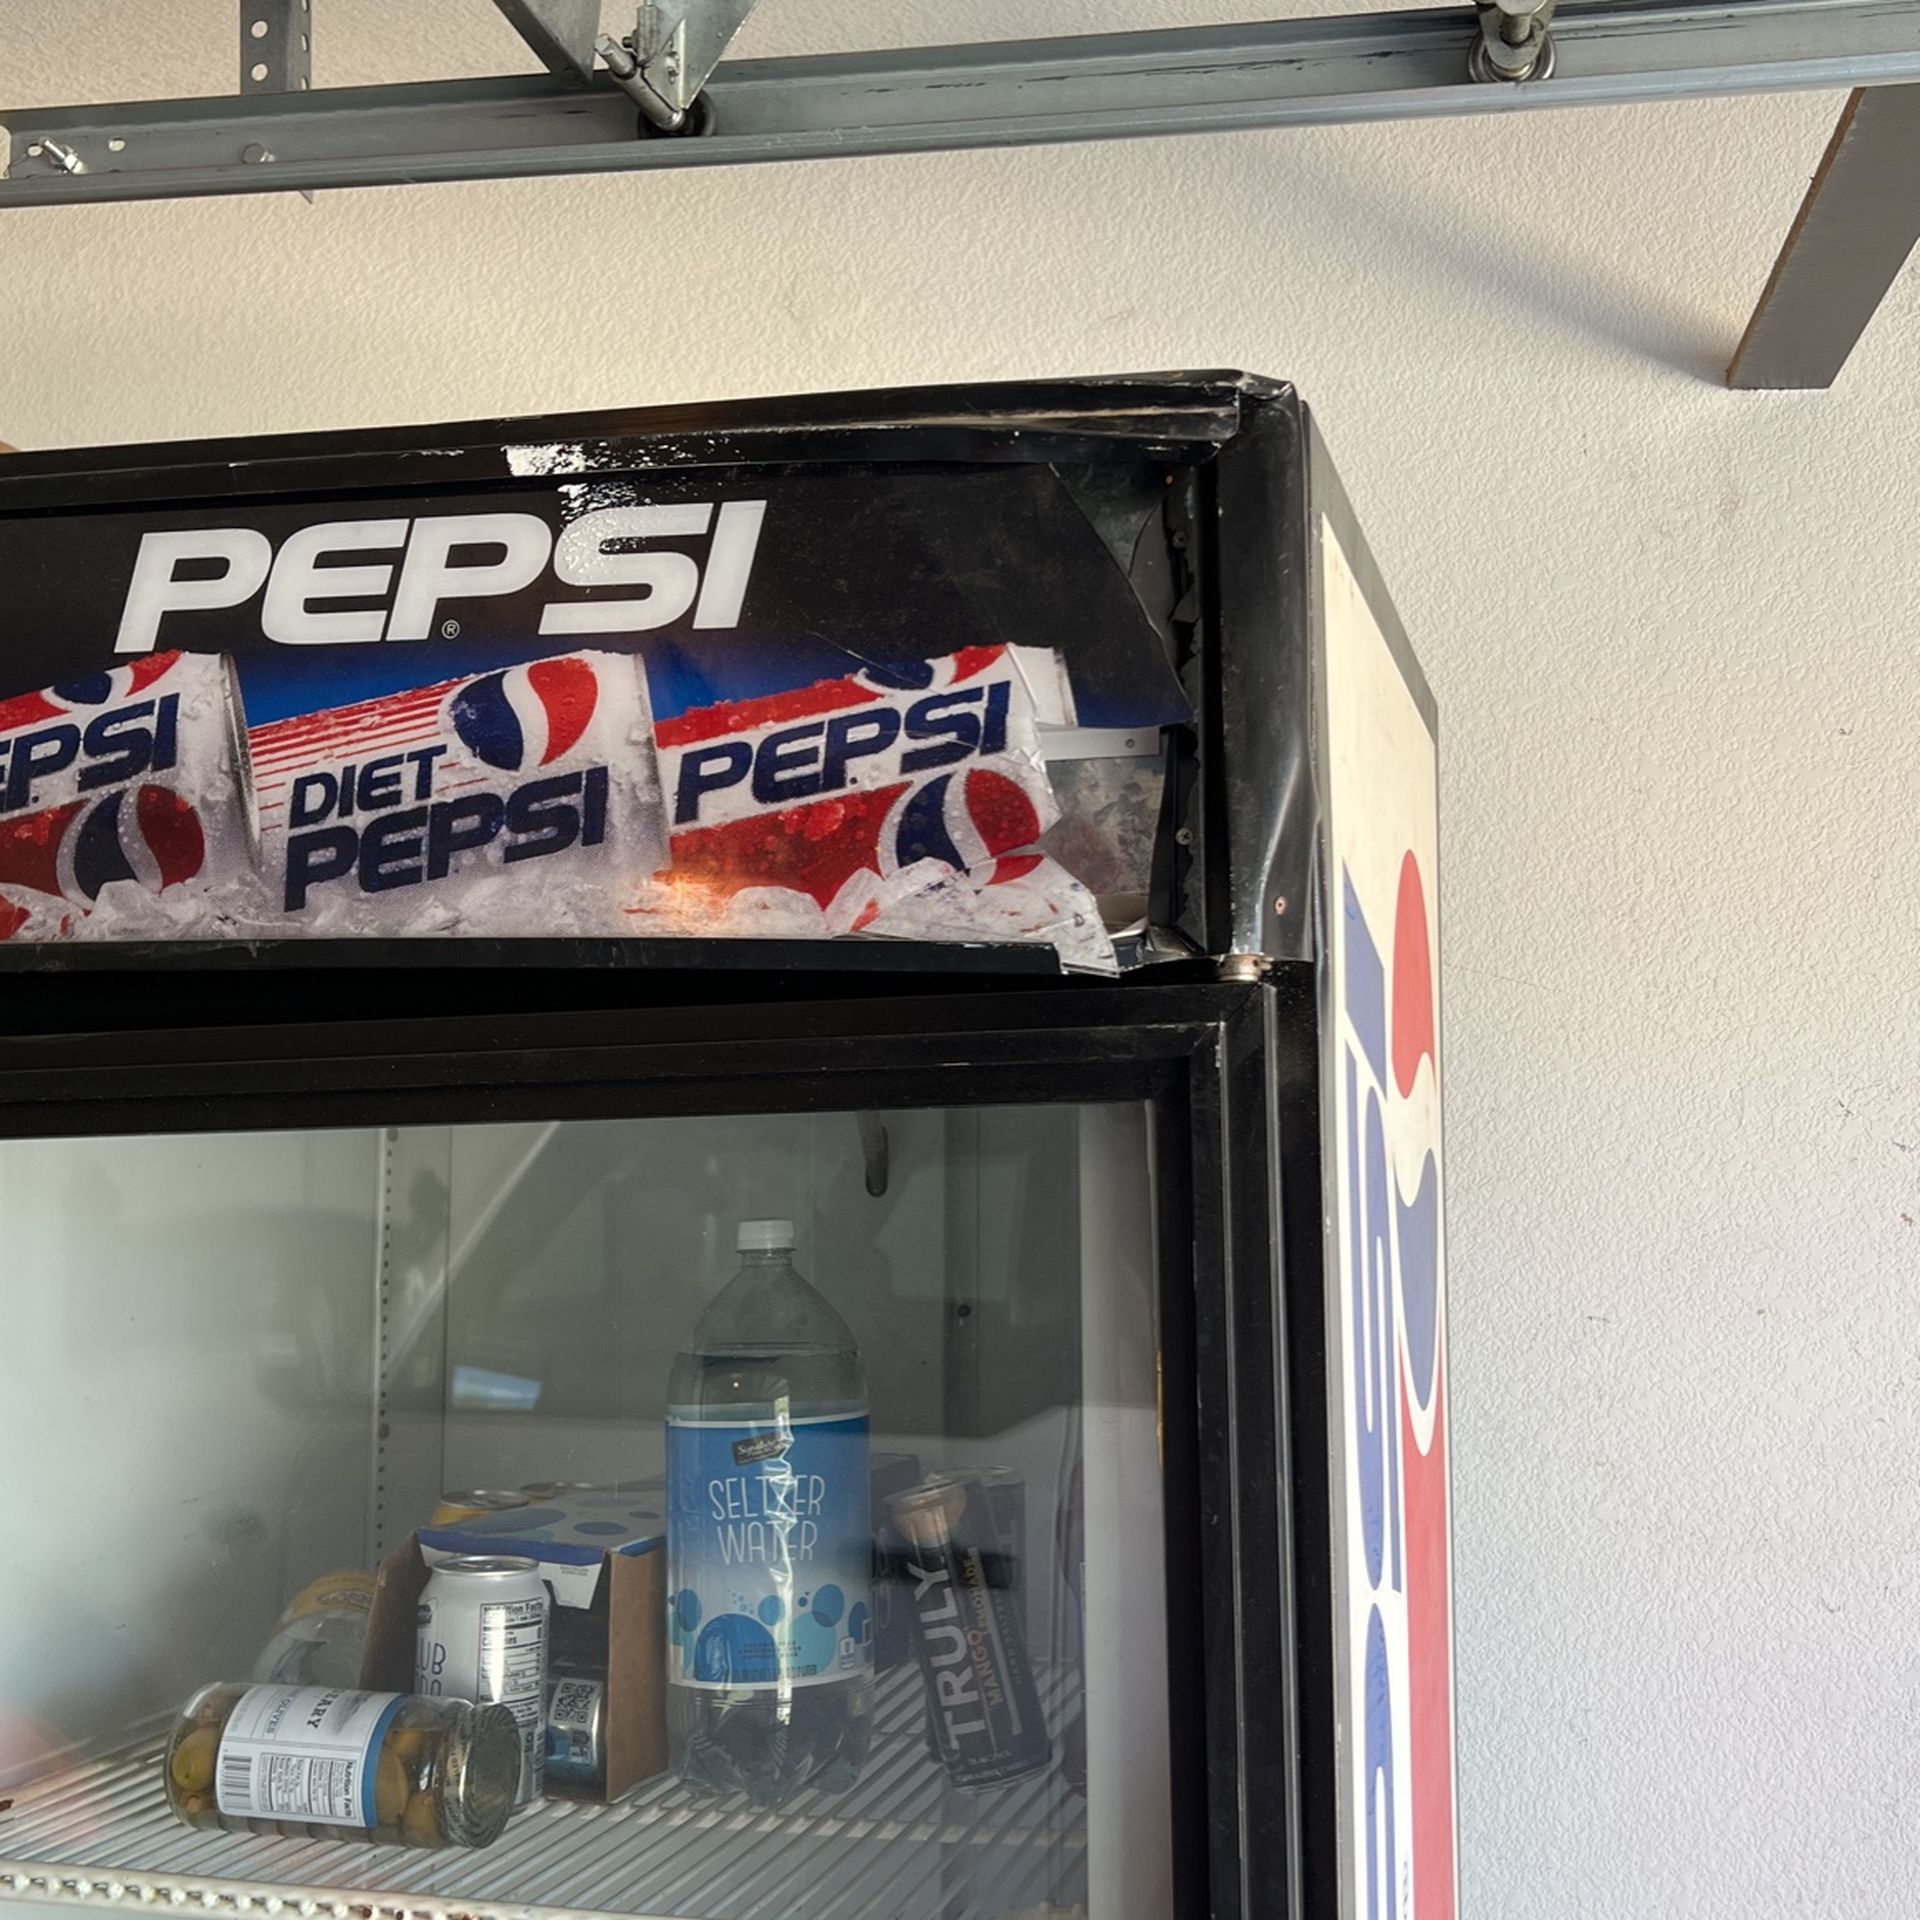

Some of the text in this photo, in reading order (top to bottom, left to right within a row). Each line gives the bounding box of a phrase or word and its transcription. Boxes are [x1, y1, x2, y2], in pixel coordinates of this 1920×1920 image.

[113, 499, 767, 653] PEPSI
[0, 693, 181, 808] PSI
[290, 744, 447, 828] DIET
[673, 680, 1011, 824] PEPSI
[283, 766, 610, 912] PEPSI
[1342, 857, 1402, 1920] PSI
[708, 1474, 826, 1521] SELTZER
[717, 1520, 818, 1566] WATER
[416, 1637, 447, 1676] UB
[907, 1561, 988, 1750] TRULY
[966, 1627, 1006, 1711] MANGO
